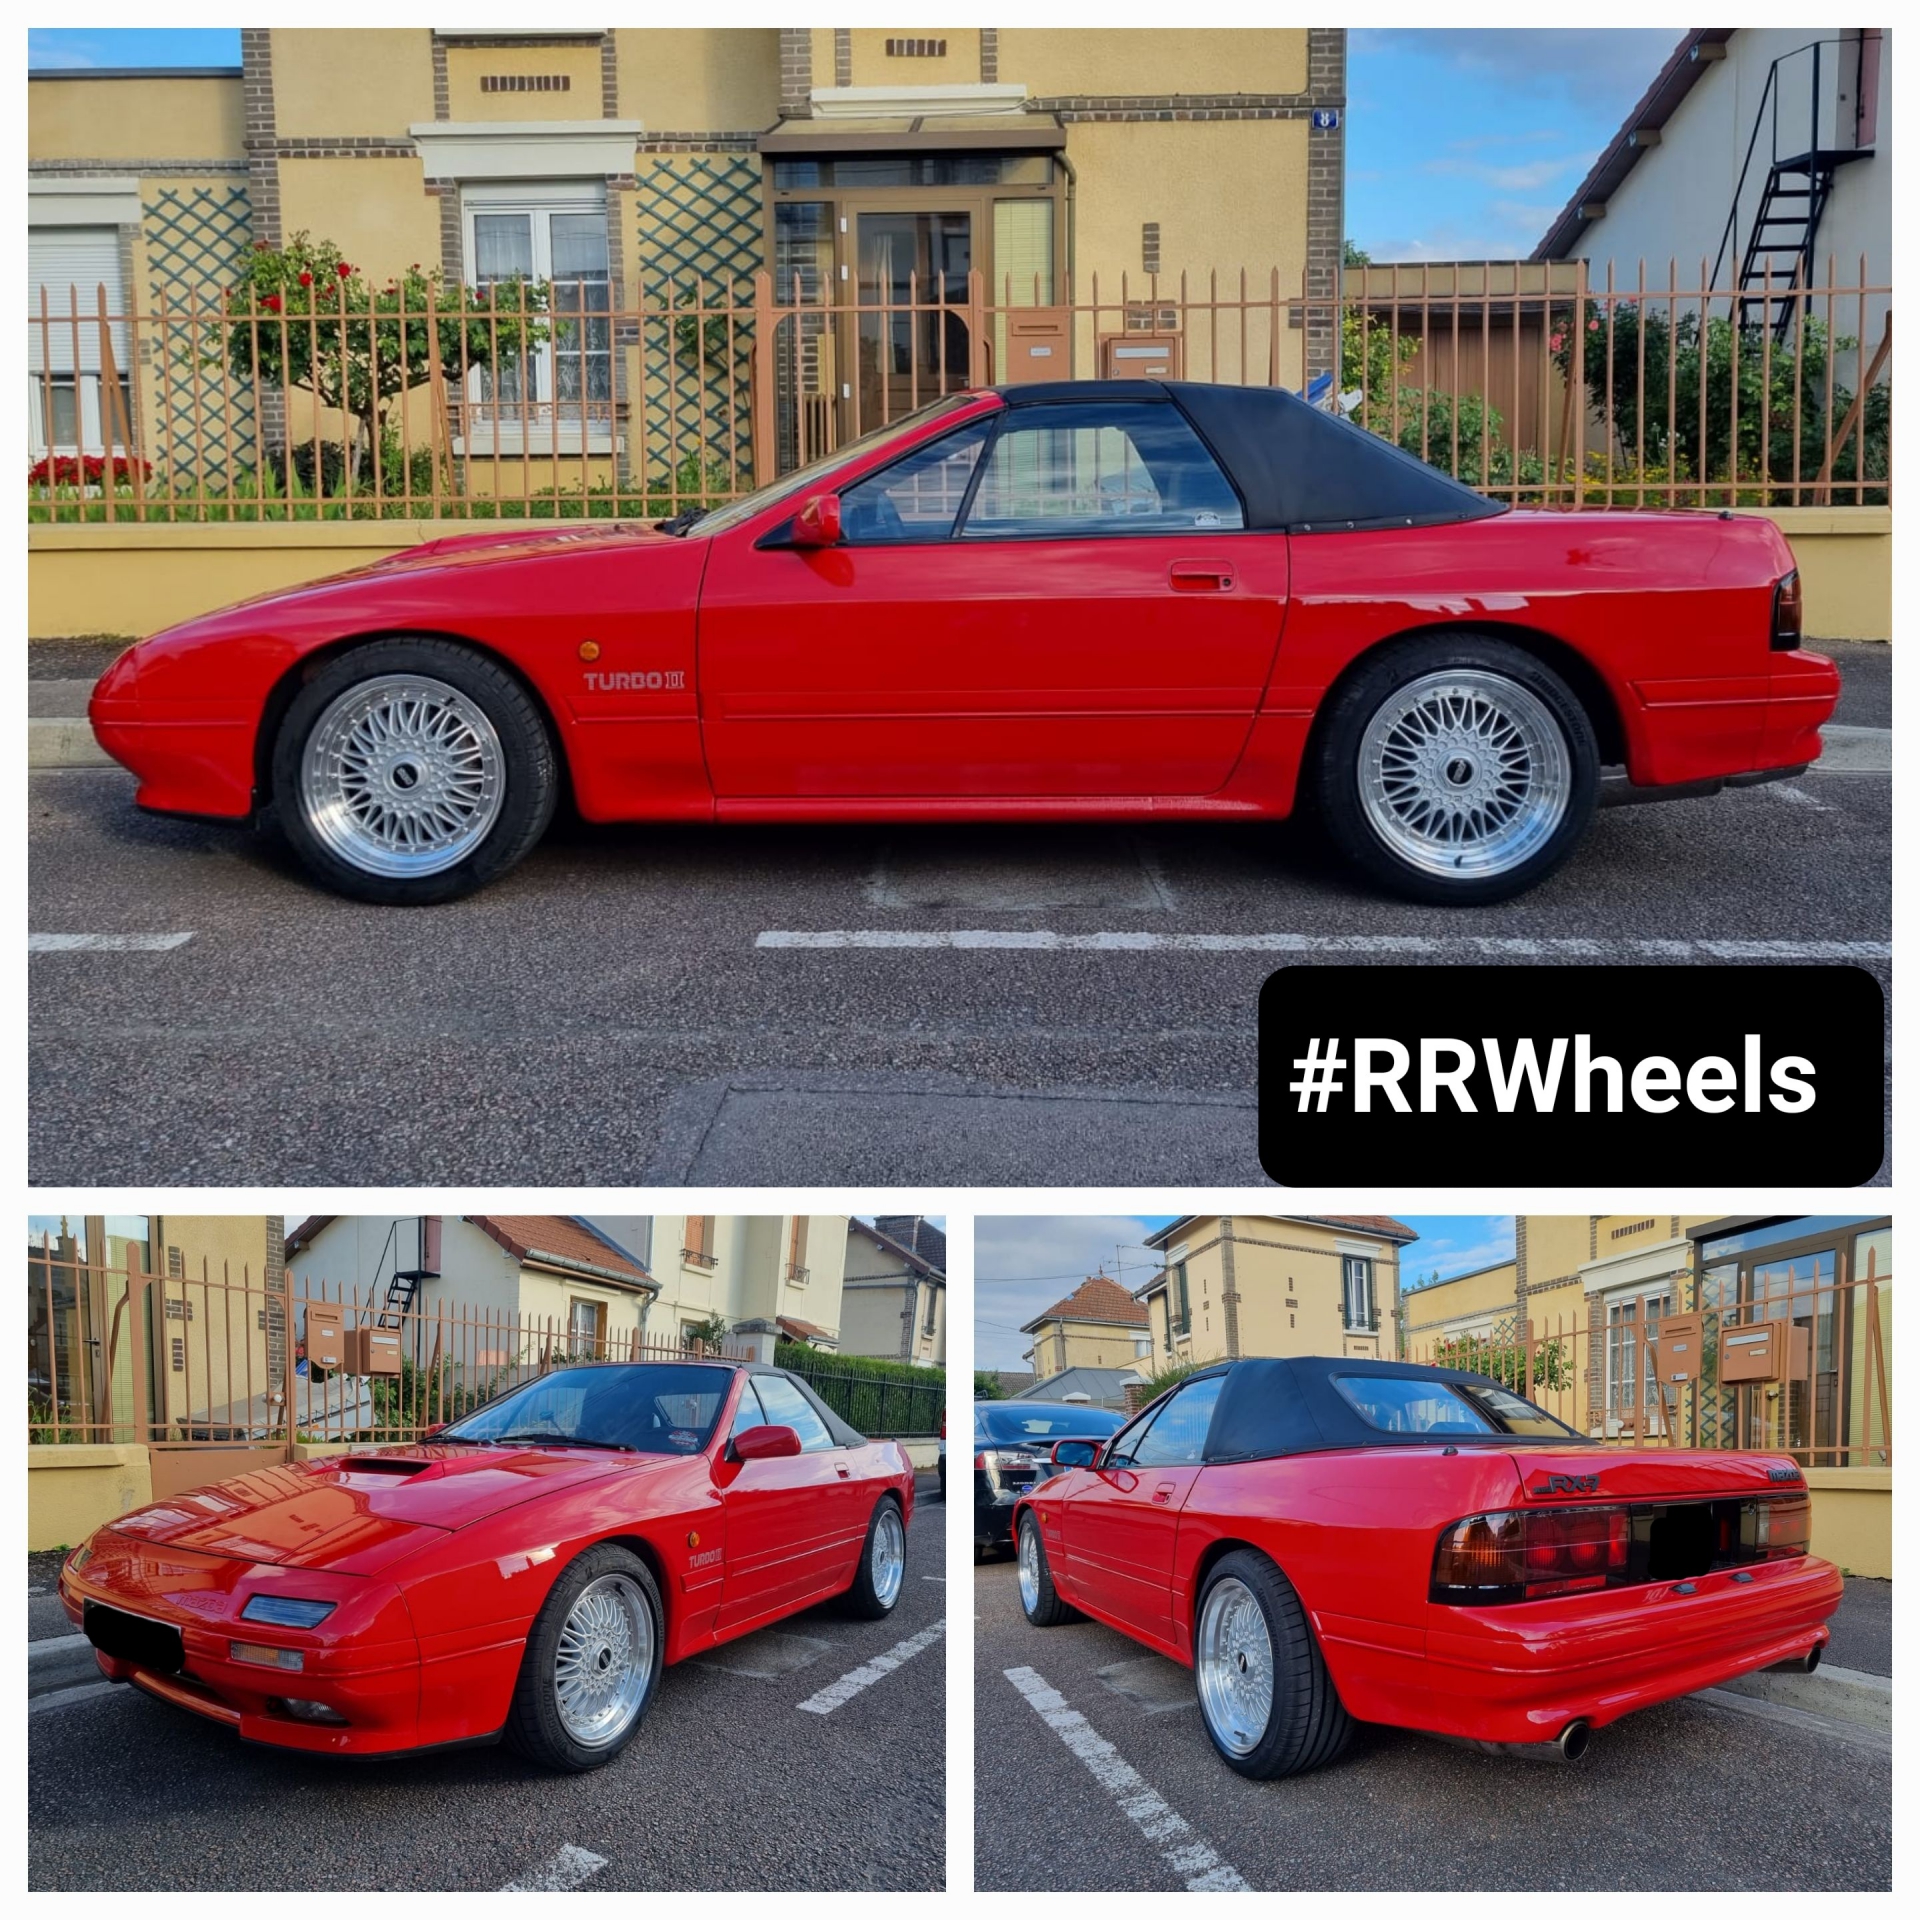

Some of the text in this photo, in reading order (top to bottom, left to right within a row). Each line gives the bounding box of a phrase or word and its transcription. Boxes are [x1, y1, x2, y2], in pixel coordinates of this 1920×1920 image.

[1320, 111, 1330, 127] 8
[583, 671, 663, 690] TURBO
[1548, 1475, 1600, 1493] RX-7
[689, 1550, 715, 1569] TURBO
[176, 1595, 229, 1615] mazda
